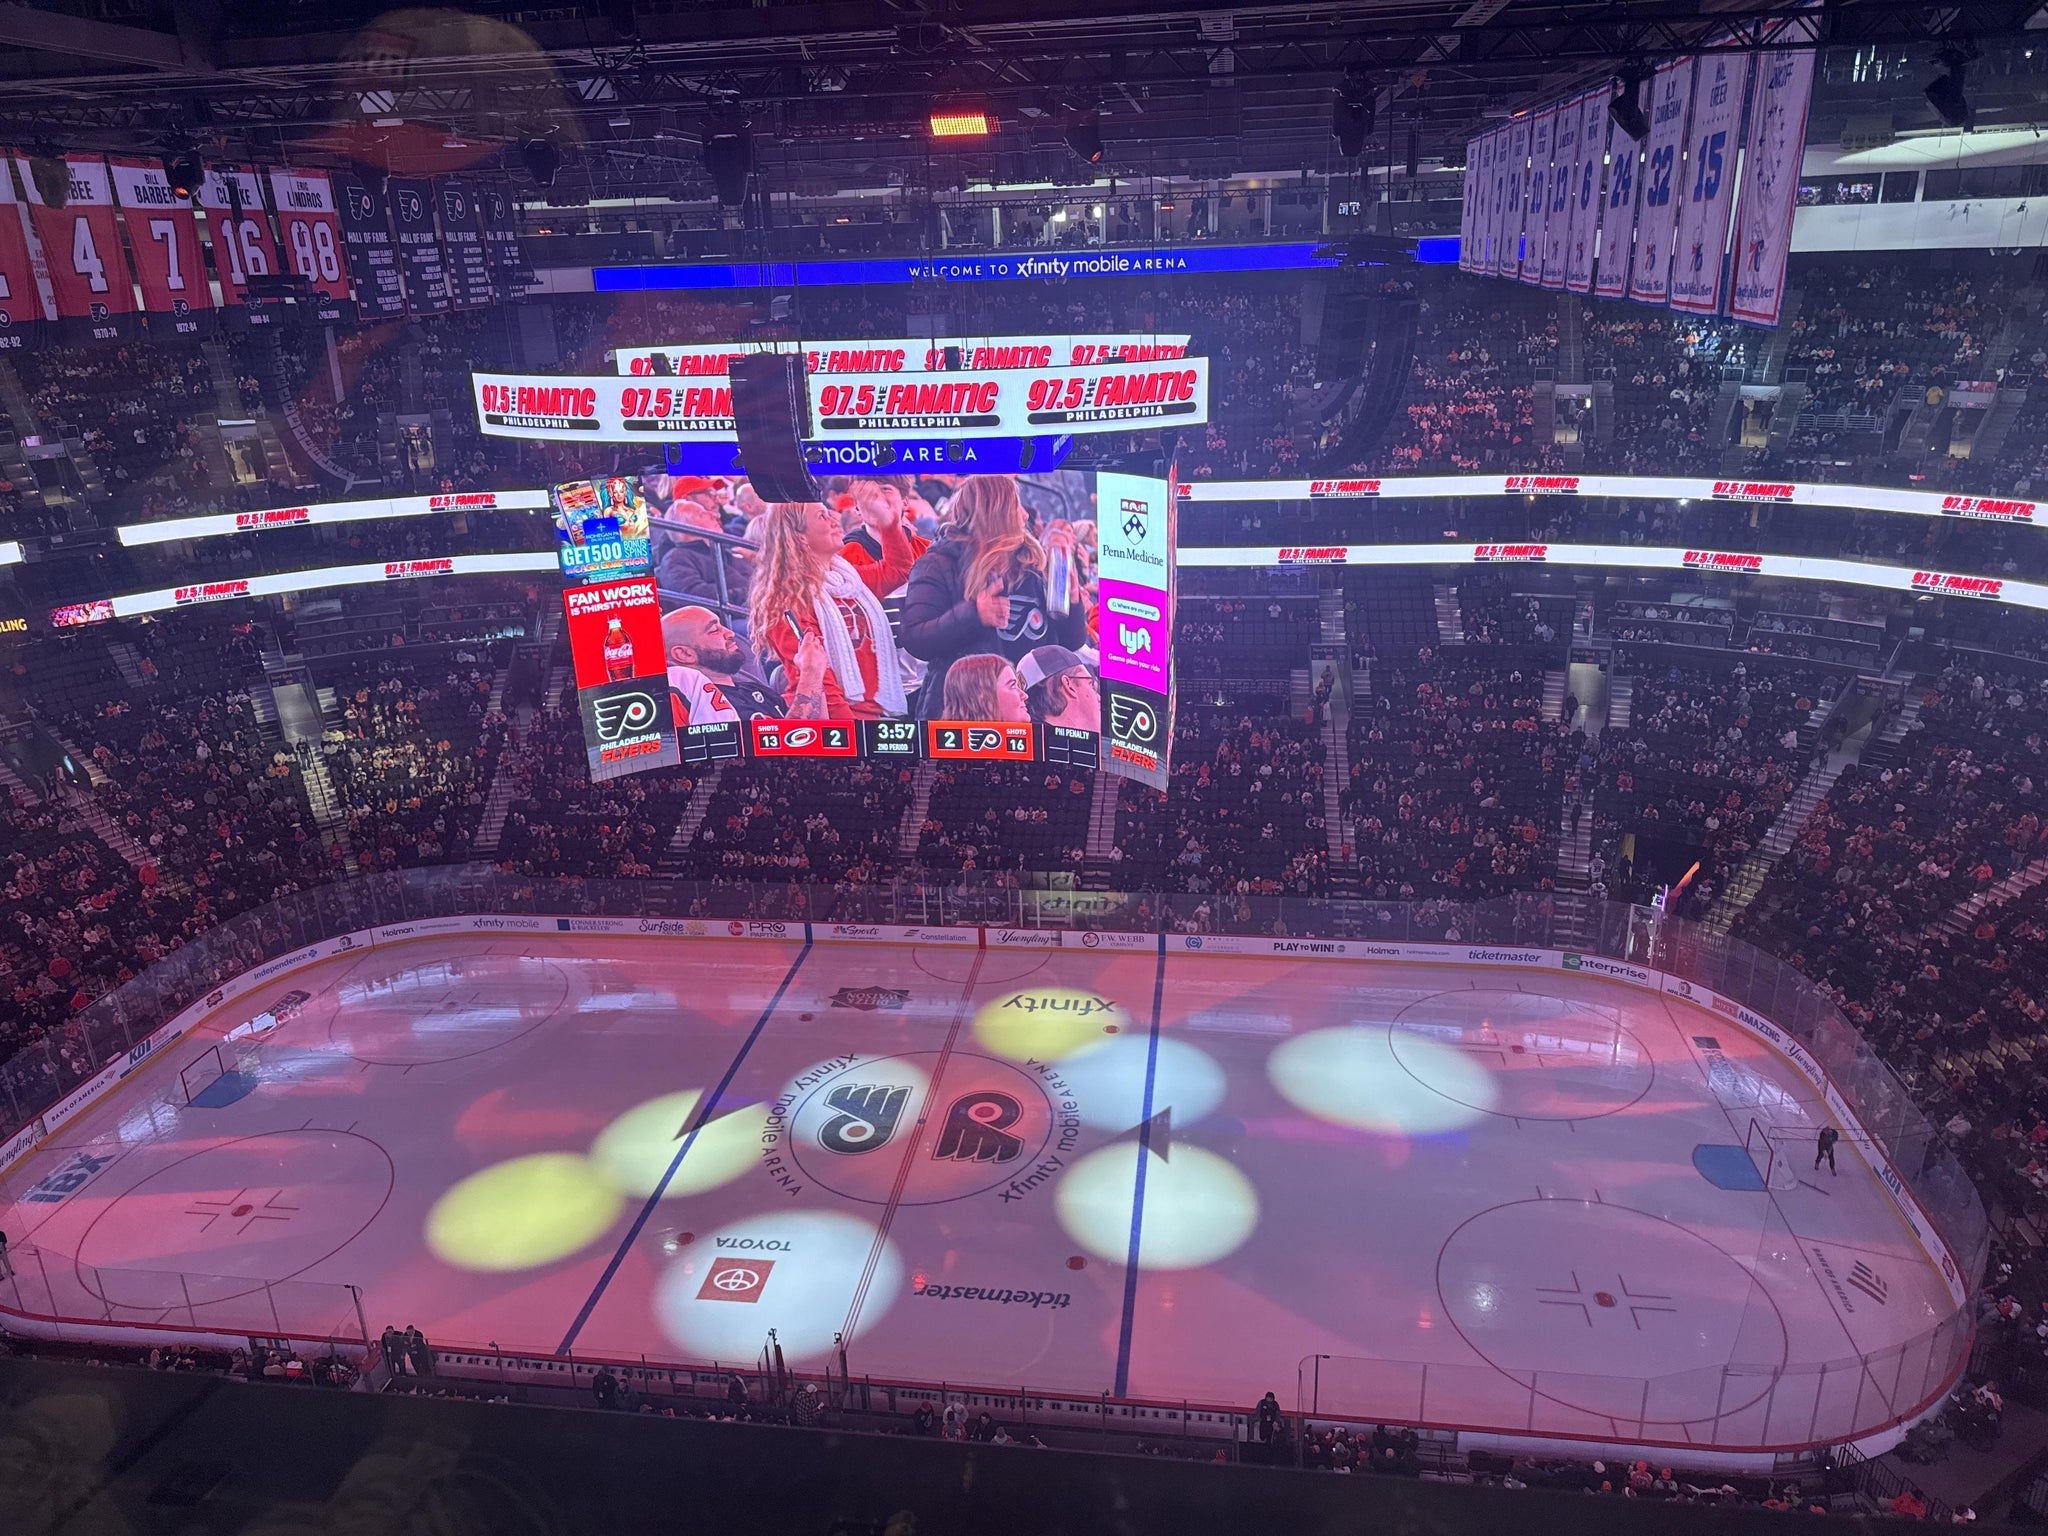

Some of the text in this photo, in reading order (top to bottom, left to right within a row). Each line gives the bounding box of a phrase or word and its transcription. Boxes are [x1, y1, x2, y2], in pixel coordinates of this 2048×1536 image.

[1646, 145, 1674, 208] 32
[1692, 131, 1727, 203] 15
[1581, 160, 1593, 210] 6
[1609, 150, 1634, 208] 24
[134, 185, 177, 204] BARBER
[287, 191, 323, 209] LINDROS
[73, 215, 110, 293] 4
[149, 217, 186, 290] 7
[221, 218, 270, 285] 16
[290, 220, 341, 284] 88
[909, 255, 1187, 278] WELCOME TO xfinity mobile ARENA
[93, 327, 118, 339] 1970-74
[828, 349, 905, 372] FANATIC
[972, 345, 1052, 370] FANATIC
[819, 381, 999, 416] 97.5 THE FANATIC
[1026, 369, 1197, 411] 97.5 THE FANATIC
[482, 384, 596, 417] 97.5 THE FANATIC
[621, 388, 685, 417] 97.5 THE
[502, 415, 570, 430] PHILADELPHIA
[858, 417, 961, 428] PHILADELPHIA
[1066, 405, 1164, 421] PHILADELPHIA
[902, 447, 978, 462] AREA
[1309, 480, 1381, 492] 97.5 FANATIC
[1505, 477, 1580, 489] 97.5 FANATIC
[1712, 481, 1795, 497] 97.5 FANATIC
[429, 494, 496, 507] 97.5 FANATIC
[1942, 496, 1973, 511] 97.5
[1975, 499, 2036, 516] FANATIC
[236, 508, 309, 525] 97.5 FANATIC
[562, 542, 622, 566] GET 500
[623, 539, 647, 549] BONUS
[624, 547, 648, 558] SPINS
[1278, 547, 1348, 559] 97.5 FANATIC
[1474, 545, 1548, 557] 97.5 FANATIC
[1102, 544, 1164, 567] Penn Medicine
[1683, 551, 1763, 568] 97.5 FANATIC
[385, 559, 452, 574] 97.5 FANATIC
[174, 580, 249, 600] 97.5 FANATIC
[1912, 572, 2003, 593] 97.5 FANATIC
[568, 583, 654, 607] FAN WORK
[570, 596, 655, 617] IS THIRSTY WORK
[1119, 622, 1151, 655] lyft
[1108, 652, 1160, 673] Game plan your ride
[687, 723, 729, 734] CAR PENALTY
[829, 730, 842, 746] 2
[878, 724, 915, 739] 3:57
[1065, 730, 1089, 740] PENALTY
[599, 732, 661, 752] PHILADELPHIA
[762, 736, 778, 747] 13
[944, 731, 956, 747] 2
[1009, 739, 1025, 751] 16
[1111, 737, 1157, 759] PHILADELPHIA
[601, 741, 662, 764] FLYERS
[1110, 745, 1157, 772] FLYERS
[382, 927, 414, 938] Holman
[473, 918, 539, 929] xfinity mobile
[639, 919, 684, 933] Surfside
[846, 926, 879, 937] Sports
[920, 933, 967, 942] Constellation
[996, 930, 1050, 945] Yuengling
[1118, 935, 1145, 943] WEBB
[1273, 942, 1299, 951] PLAY
[1310, 943, 1334, 952] WIN!
[1367, 946, 1400, 955] Holman
[1468, 950, 1541, 963] ticketmaster
[253, 953, 307, 980] Independence
[1563, 956, 1647, 980] enterprise
[1003, 994, 1118, 1016] xfinity
[1738, 1010, 1780, 1043] AMAZING
[129, 1038, 151, 1065] KDI
[1784, 1037, 1824, 1084] Yuengling
[51, 1080, 105, 1122] BANK OF AMERICA
[761, 1053, 859, 1198] xfinity mobile ARENA
[997, 1056, 1080, 1204] xfinity mobile ARENA
[715, 1236, 792, 1252] TOYOTA
[912, 1283, 1072, 1309] ticketmaster
